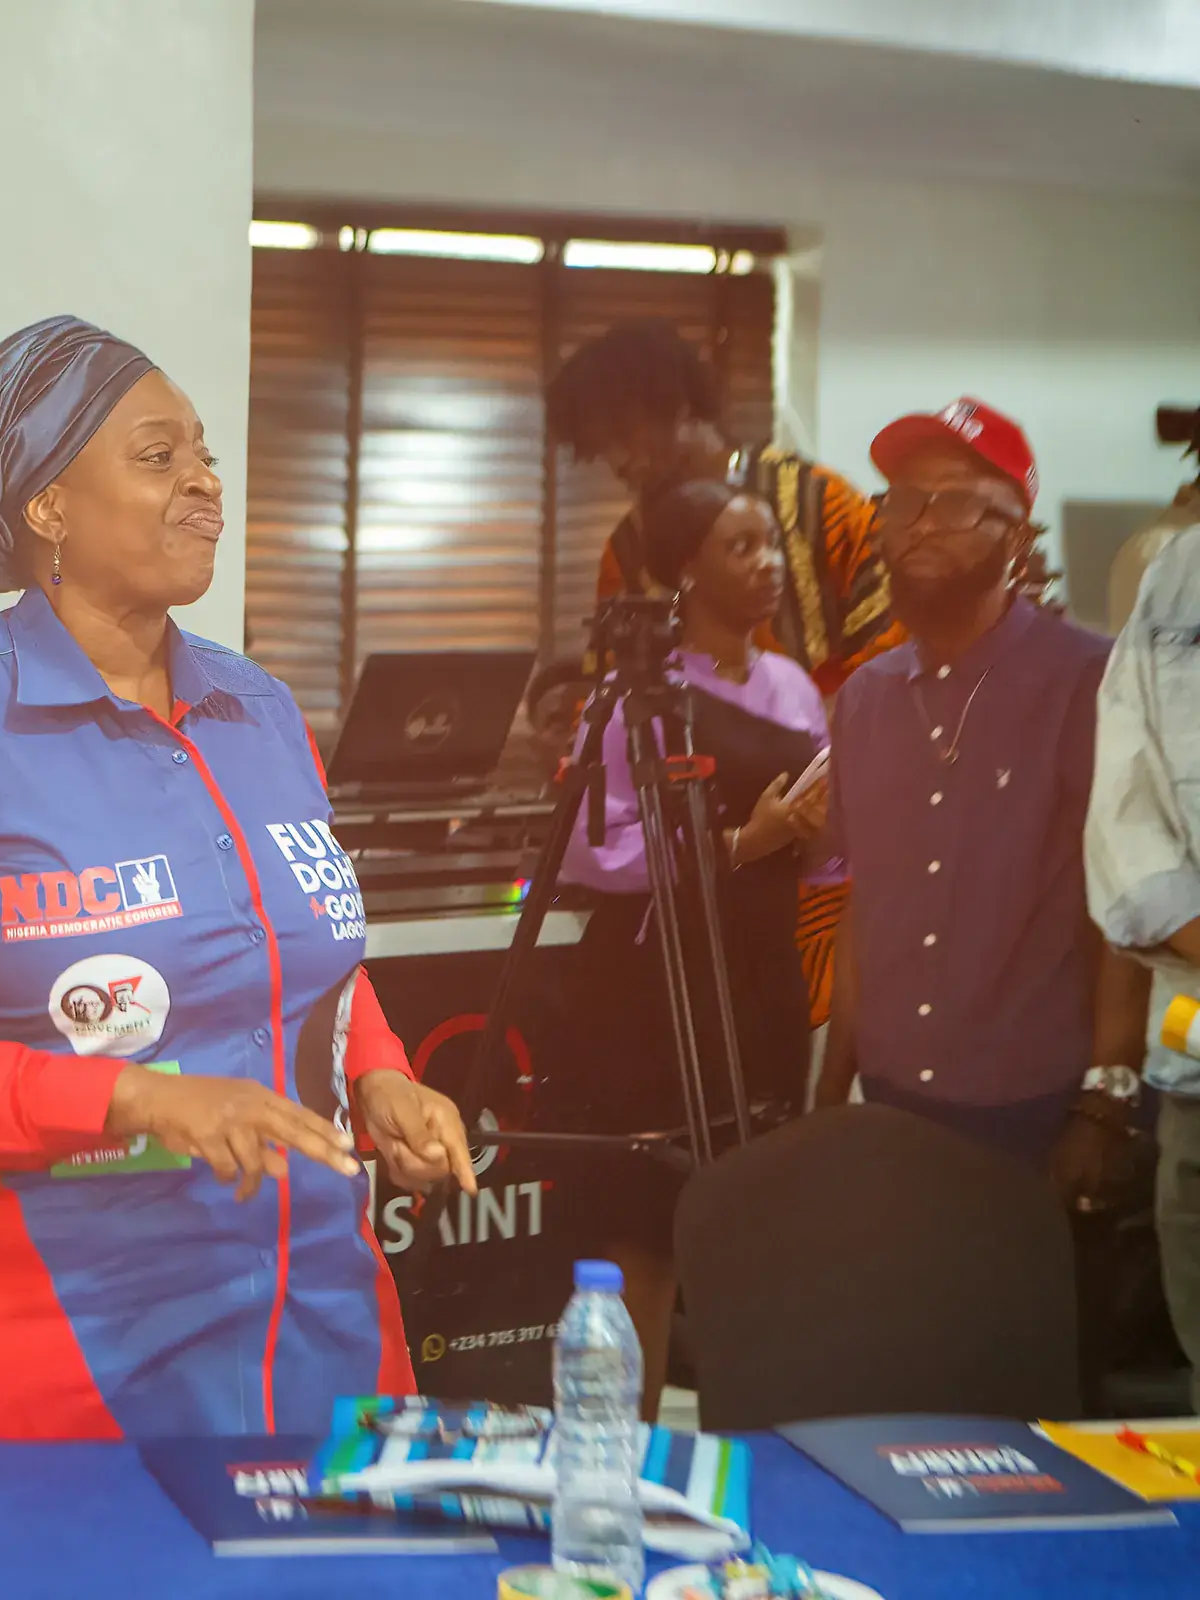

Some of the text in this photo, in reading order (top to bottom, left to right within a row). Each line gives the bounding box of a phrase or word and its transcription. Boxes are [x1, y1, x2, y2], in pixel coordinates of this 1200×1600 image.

[6, 903, 179, 940] NIGERIA DEMOCRATIC CONGRESS
